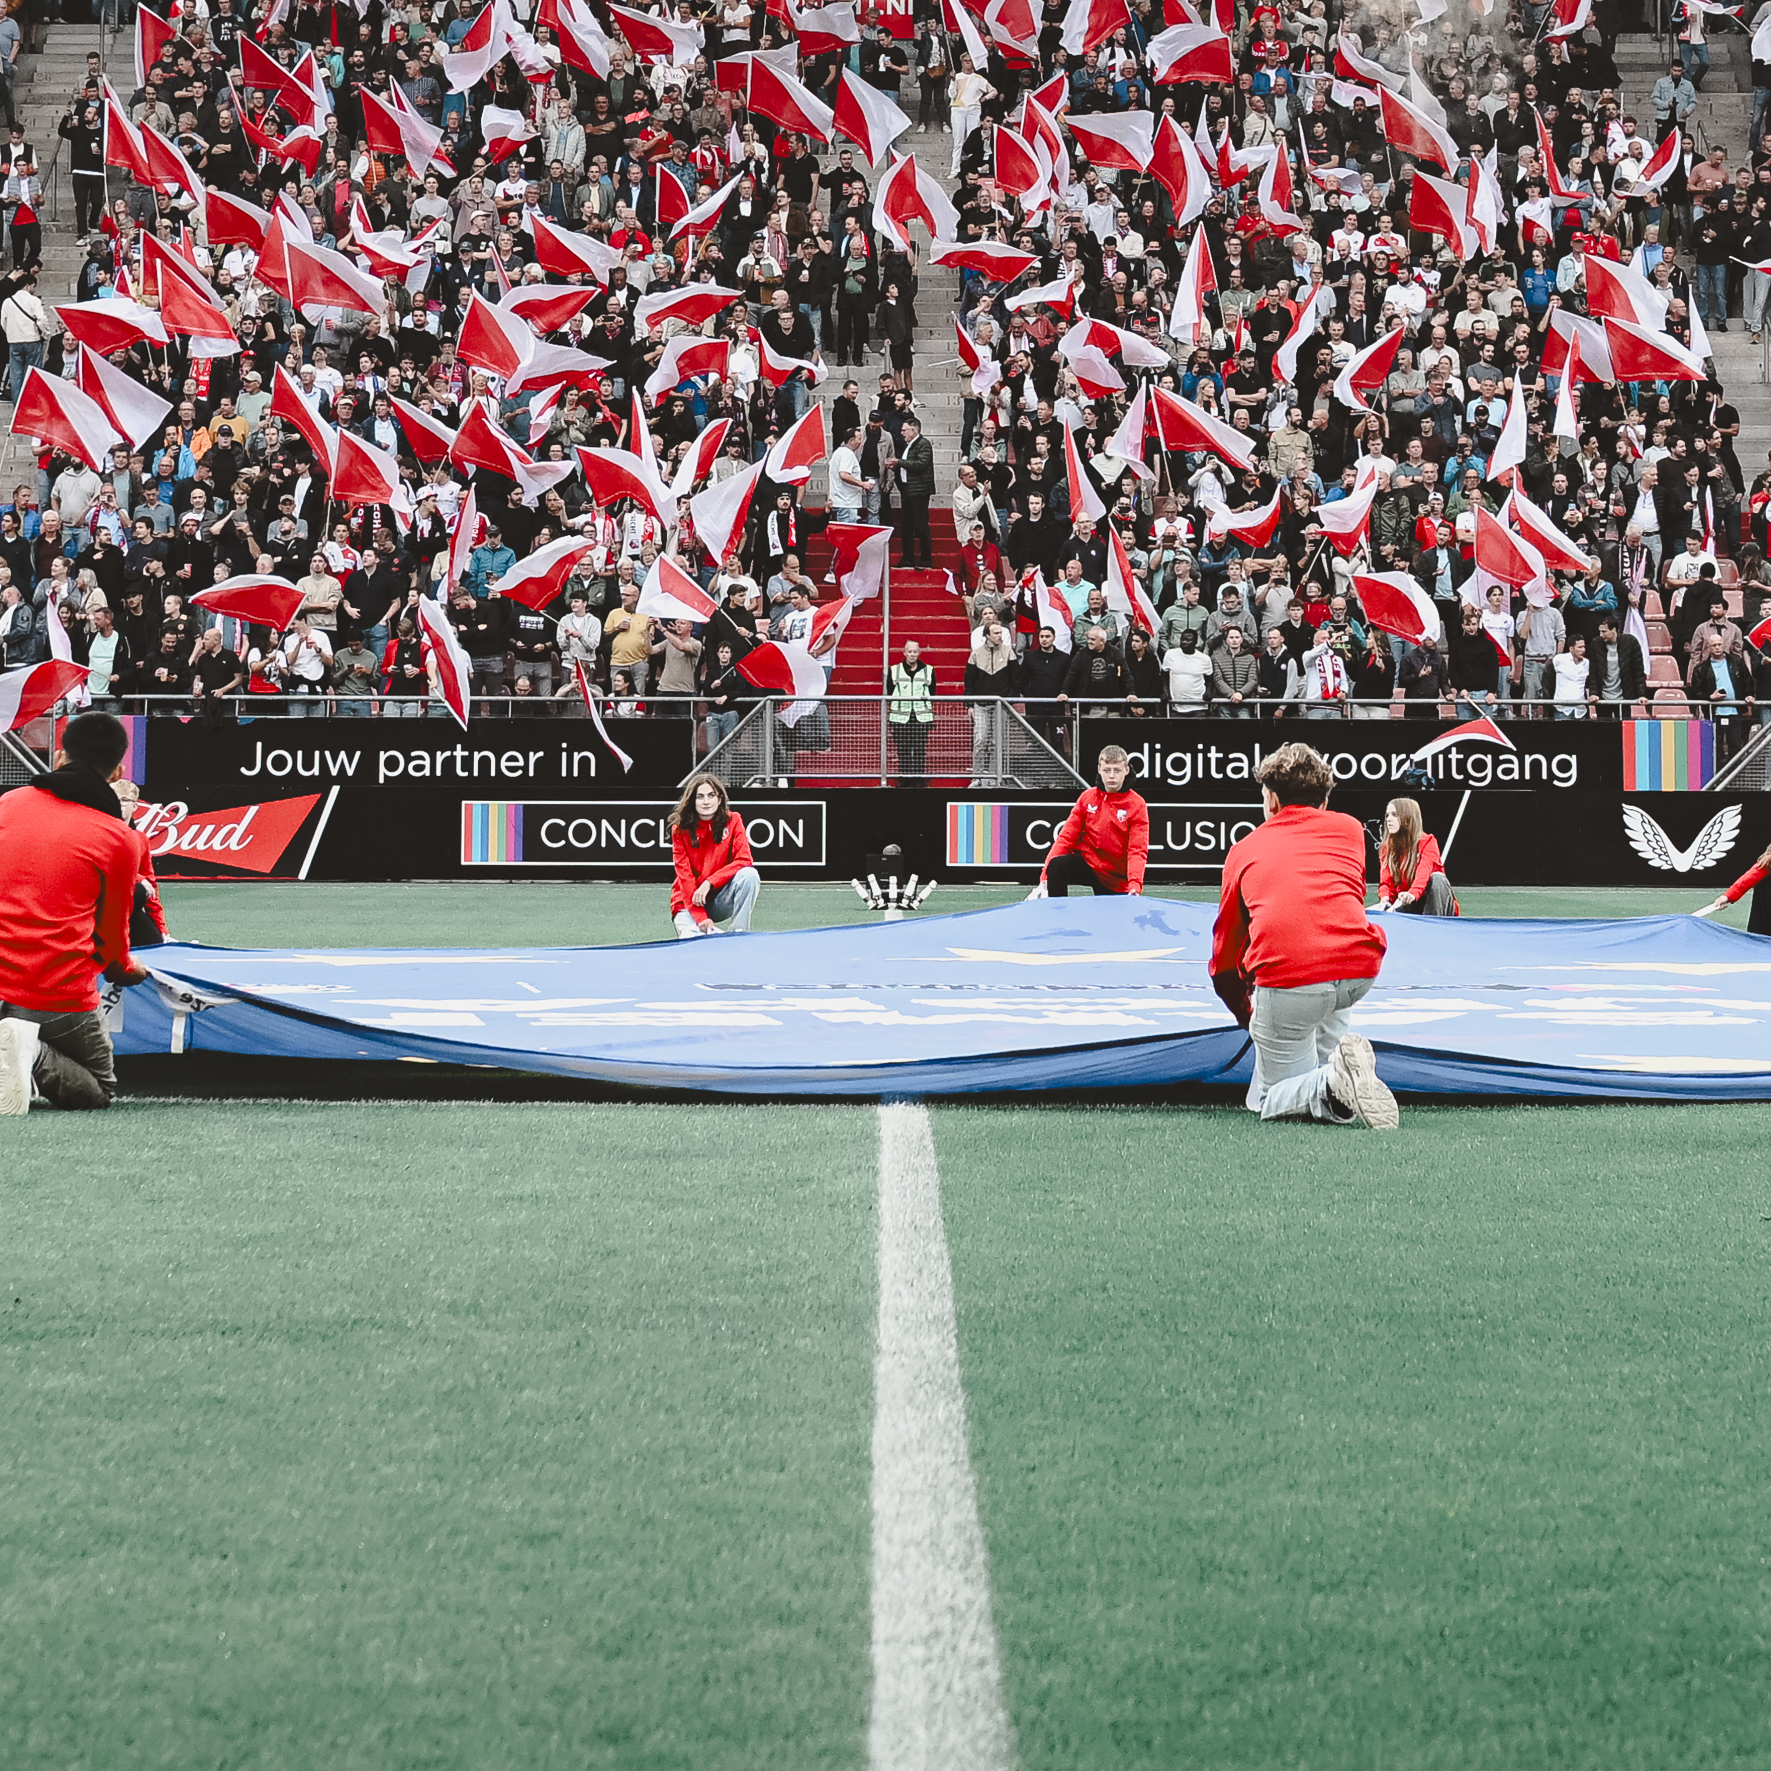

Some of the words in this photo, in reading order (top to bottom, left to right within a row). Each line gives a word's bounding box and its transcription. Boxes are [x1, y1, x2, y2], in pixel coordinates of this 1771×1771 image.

[240, 742, 359, 778] Jouw
[378, 744, 545, 784] partner
[560, 742, 596, 777] in
[1126, 743, 1260, 786] digital
[540, 818, 804, 849] CONCLON
